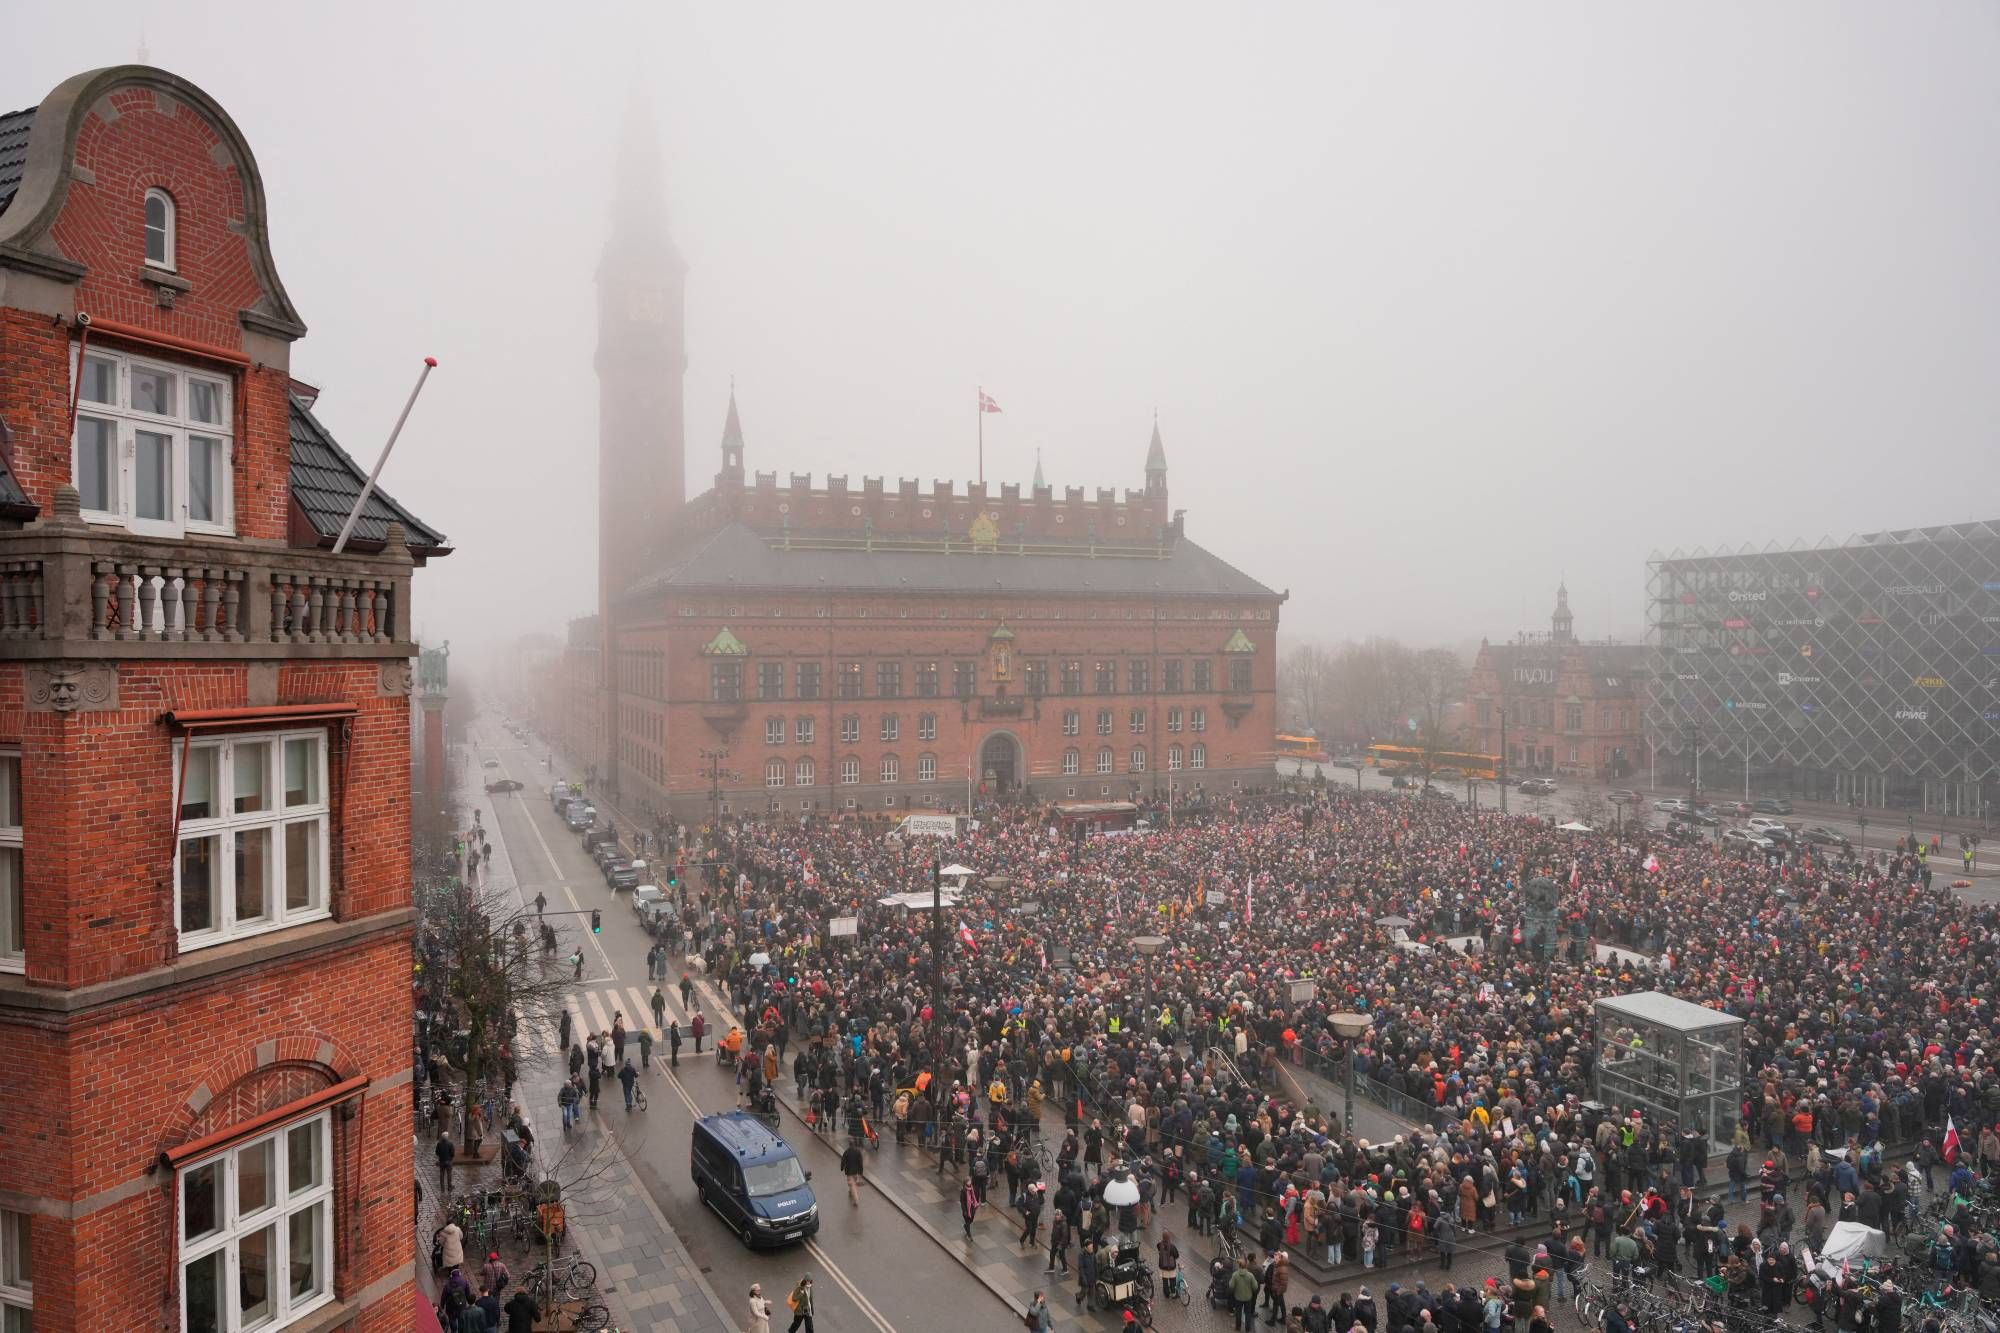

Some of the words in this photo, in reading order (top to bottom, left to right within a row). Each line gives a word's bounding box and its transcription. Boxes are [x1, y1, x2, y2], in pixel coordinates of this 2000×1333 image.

[1728, 590, 1767, 602] Ørsted
[1513, 669, 1553, 684] TIVOLI
[1895, 710, 1928, 720] KPMG
